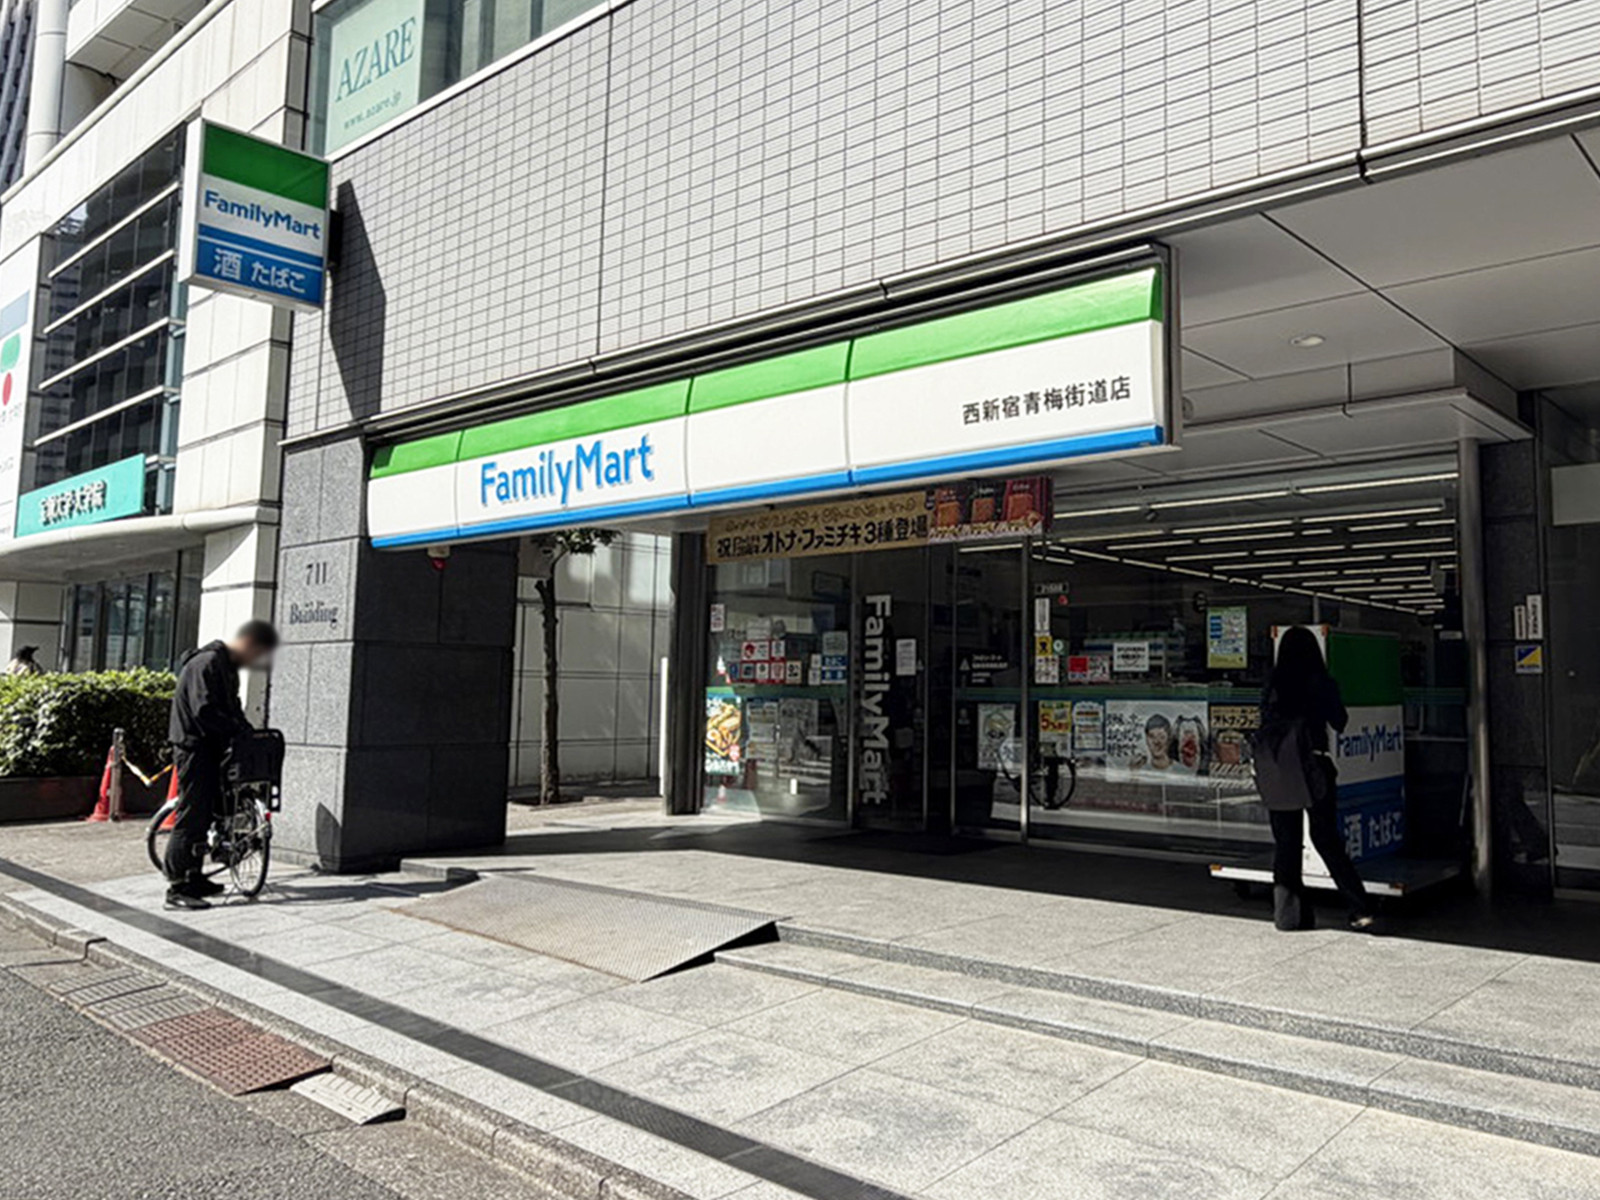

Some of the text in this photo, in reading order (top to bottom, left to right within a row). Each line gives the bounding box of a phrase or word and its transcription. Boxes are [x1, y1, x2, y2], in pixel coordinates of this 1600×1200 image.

[335, 16, 416, 103] AZARE
[204, 189, 321, 240] FamilyMart
[213, 247, 306, 294] 酒 たばこ
[962, 375, 1132, 426] 西新宿青梅街道店
[480, 434, 655, 508] FamilyMart
[306, 562, 327, 586] 711
[289, 601, 339, 630] Building
[861, 594, 893, 805] FamilyMart
[1336, 723, 1402, 762] FamilyMart
[1343, 809, 1403, 861] 酒 たばこ
